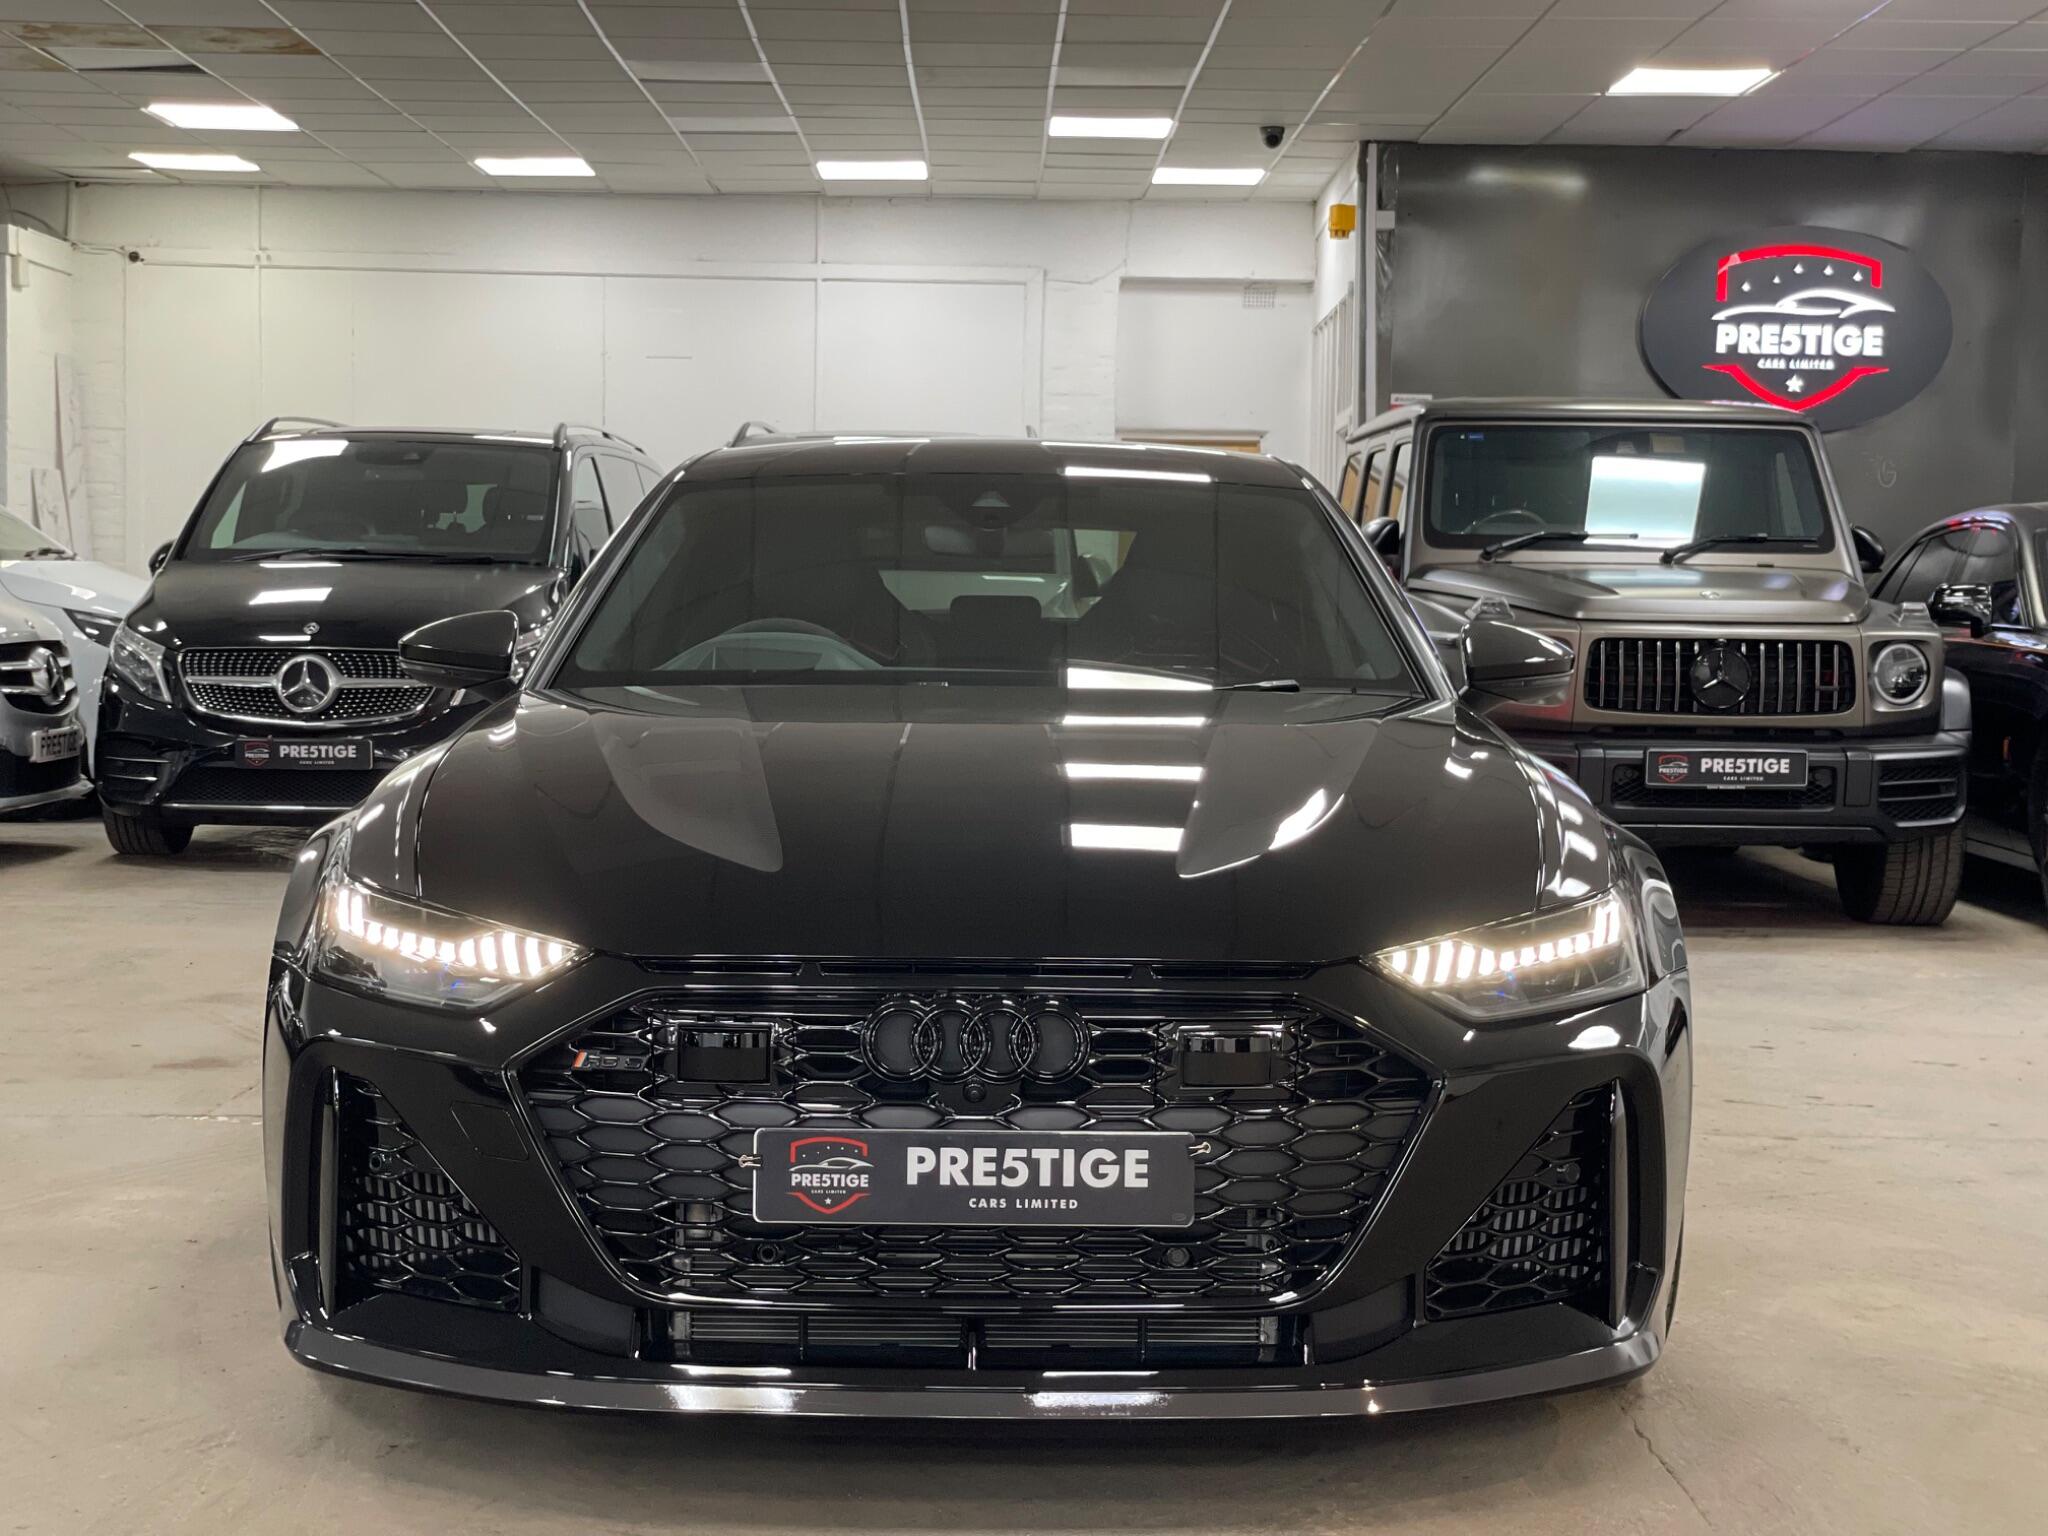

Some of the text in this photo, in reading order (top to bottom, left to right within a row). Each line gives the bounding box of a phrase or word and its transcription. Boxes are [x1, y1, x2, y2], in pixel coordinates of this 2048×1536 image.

[1715, 323, 1884, 357] PRE5TIGE
[1789, 358, 1835, 370] LIMITED
[279, 745, 357, 758] PRE5TIGE
[1700, 758, 1790, 774] PRE5TIGE
[906, 1146, 1150, 1189] PRE5TIGE
[791, 1173, 869, 1187] PRE5TIGE
[968, 1197, 1079, 1210] CARS LIMITED
